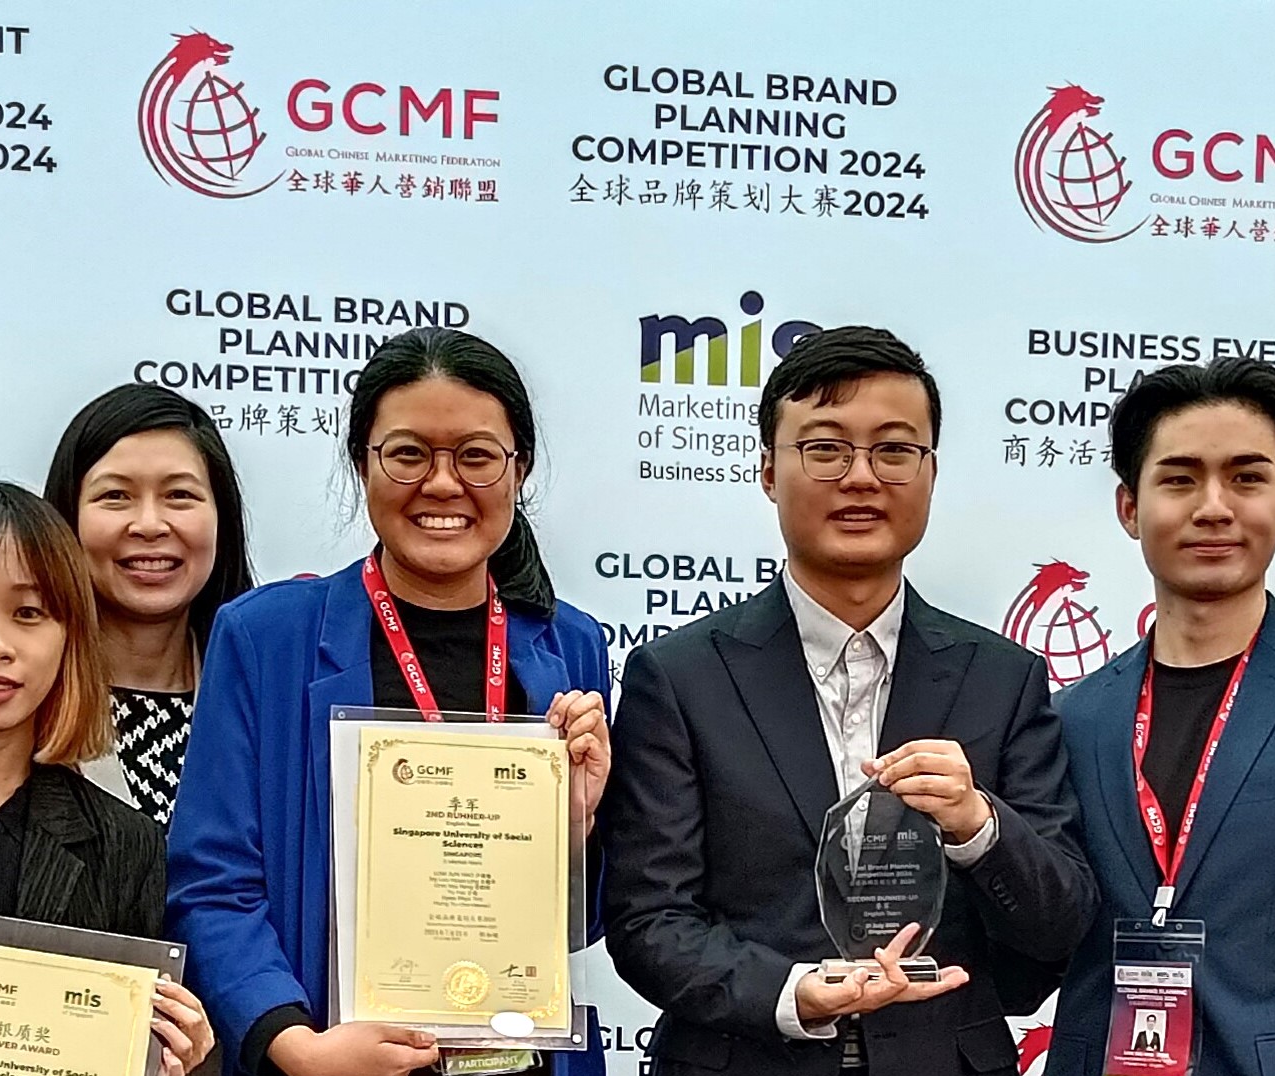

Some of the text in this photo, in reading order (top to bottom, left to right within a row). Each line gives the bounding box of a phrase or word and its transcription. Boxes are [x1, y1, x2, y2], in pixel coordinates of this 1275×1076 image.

[604, 65, 896, 105] GLOBAL BRAND
[287, 79, 499, 139] GCMF
[656, 104, 845, 139] PLANNING
[376, 152, 437, 164] MARKETING
[441, 155, 500, 167] FEDERATION
[572, 135, 925, 179] COMPETITION 2024
[166, 289, 469, 328] GLOBAL BRAND
[1029, 329, 1200, 362] BUSINESS
[639, 393, 760, 426] Marketing
[639, 425, 761, 457] of Singap
[640, 461, 724, 482] Business
[595, 553, 743, 582] GLOBAL
[380, 602, 399, 633] GCMF
[492, 645, 502, 675] GCMF
[407, 664, 426, 695] GCMF
[417, 764, 526, 780] GCMF mis
[393, 827, 441, 837] Singapore
[443, 830, 490, 840] University
[504, 833, 532, 841] Social
[442, 840, 483, 849] Sciences
[65, 989, 101, 1007] mis
[20, 1043, 61, 1056] AWARD
[459, 1056, 518, 1069] PARTICIPANT
[52, 1068, 64, 1076] of
